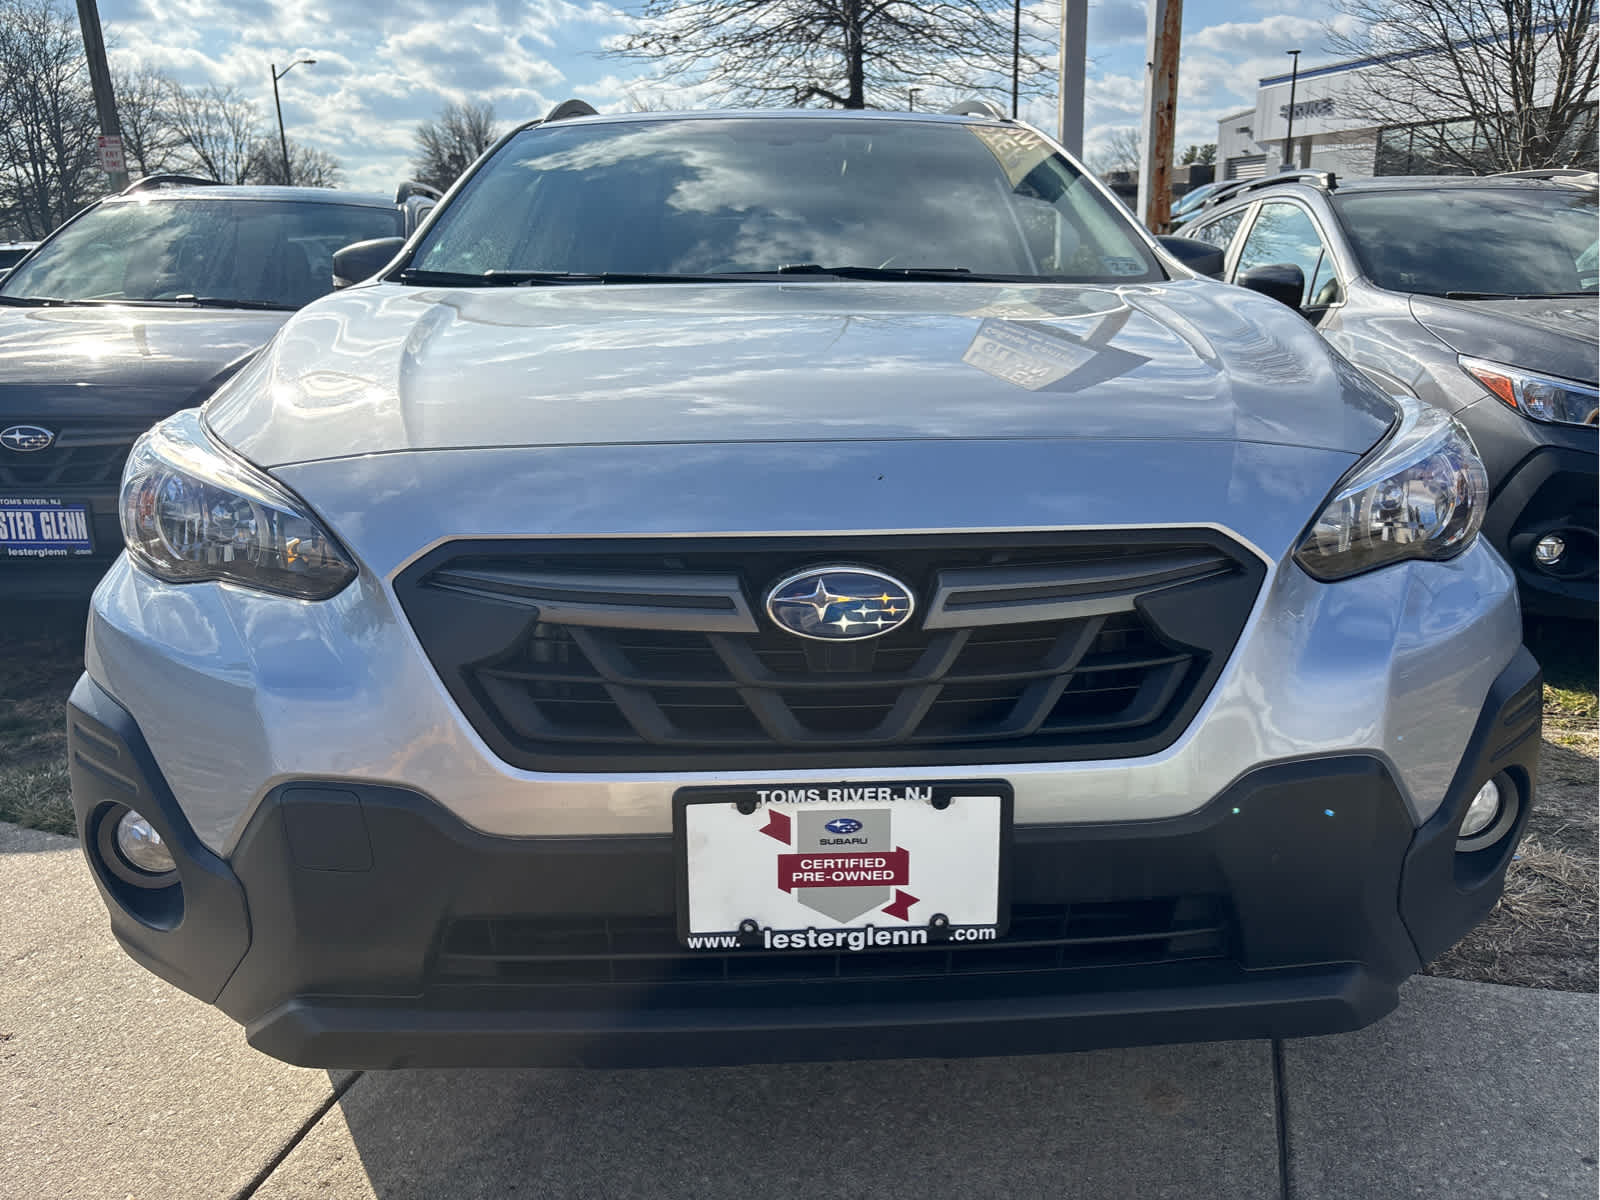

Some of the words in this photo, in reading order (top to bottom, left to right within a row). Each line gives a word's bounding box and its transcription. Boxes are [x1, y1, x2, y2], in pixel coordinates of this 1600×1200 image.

[40, 511, 89, 540] GLENN
[757, 789, 820, 805] TOMS
[905, 786, 933, 801] NJ
[819, 838, 868, 846] SUBARU
[800, 858, 887, 870] CERTIFIED
[792, 870, 895, 882] PRE-OWNED
[687, 934, 741, 949] www.
[764, 927, 928, 951] lesterglenn
[949, 926, 997, 942] .com
